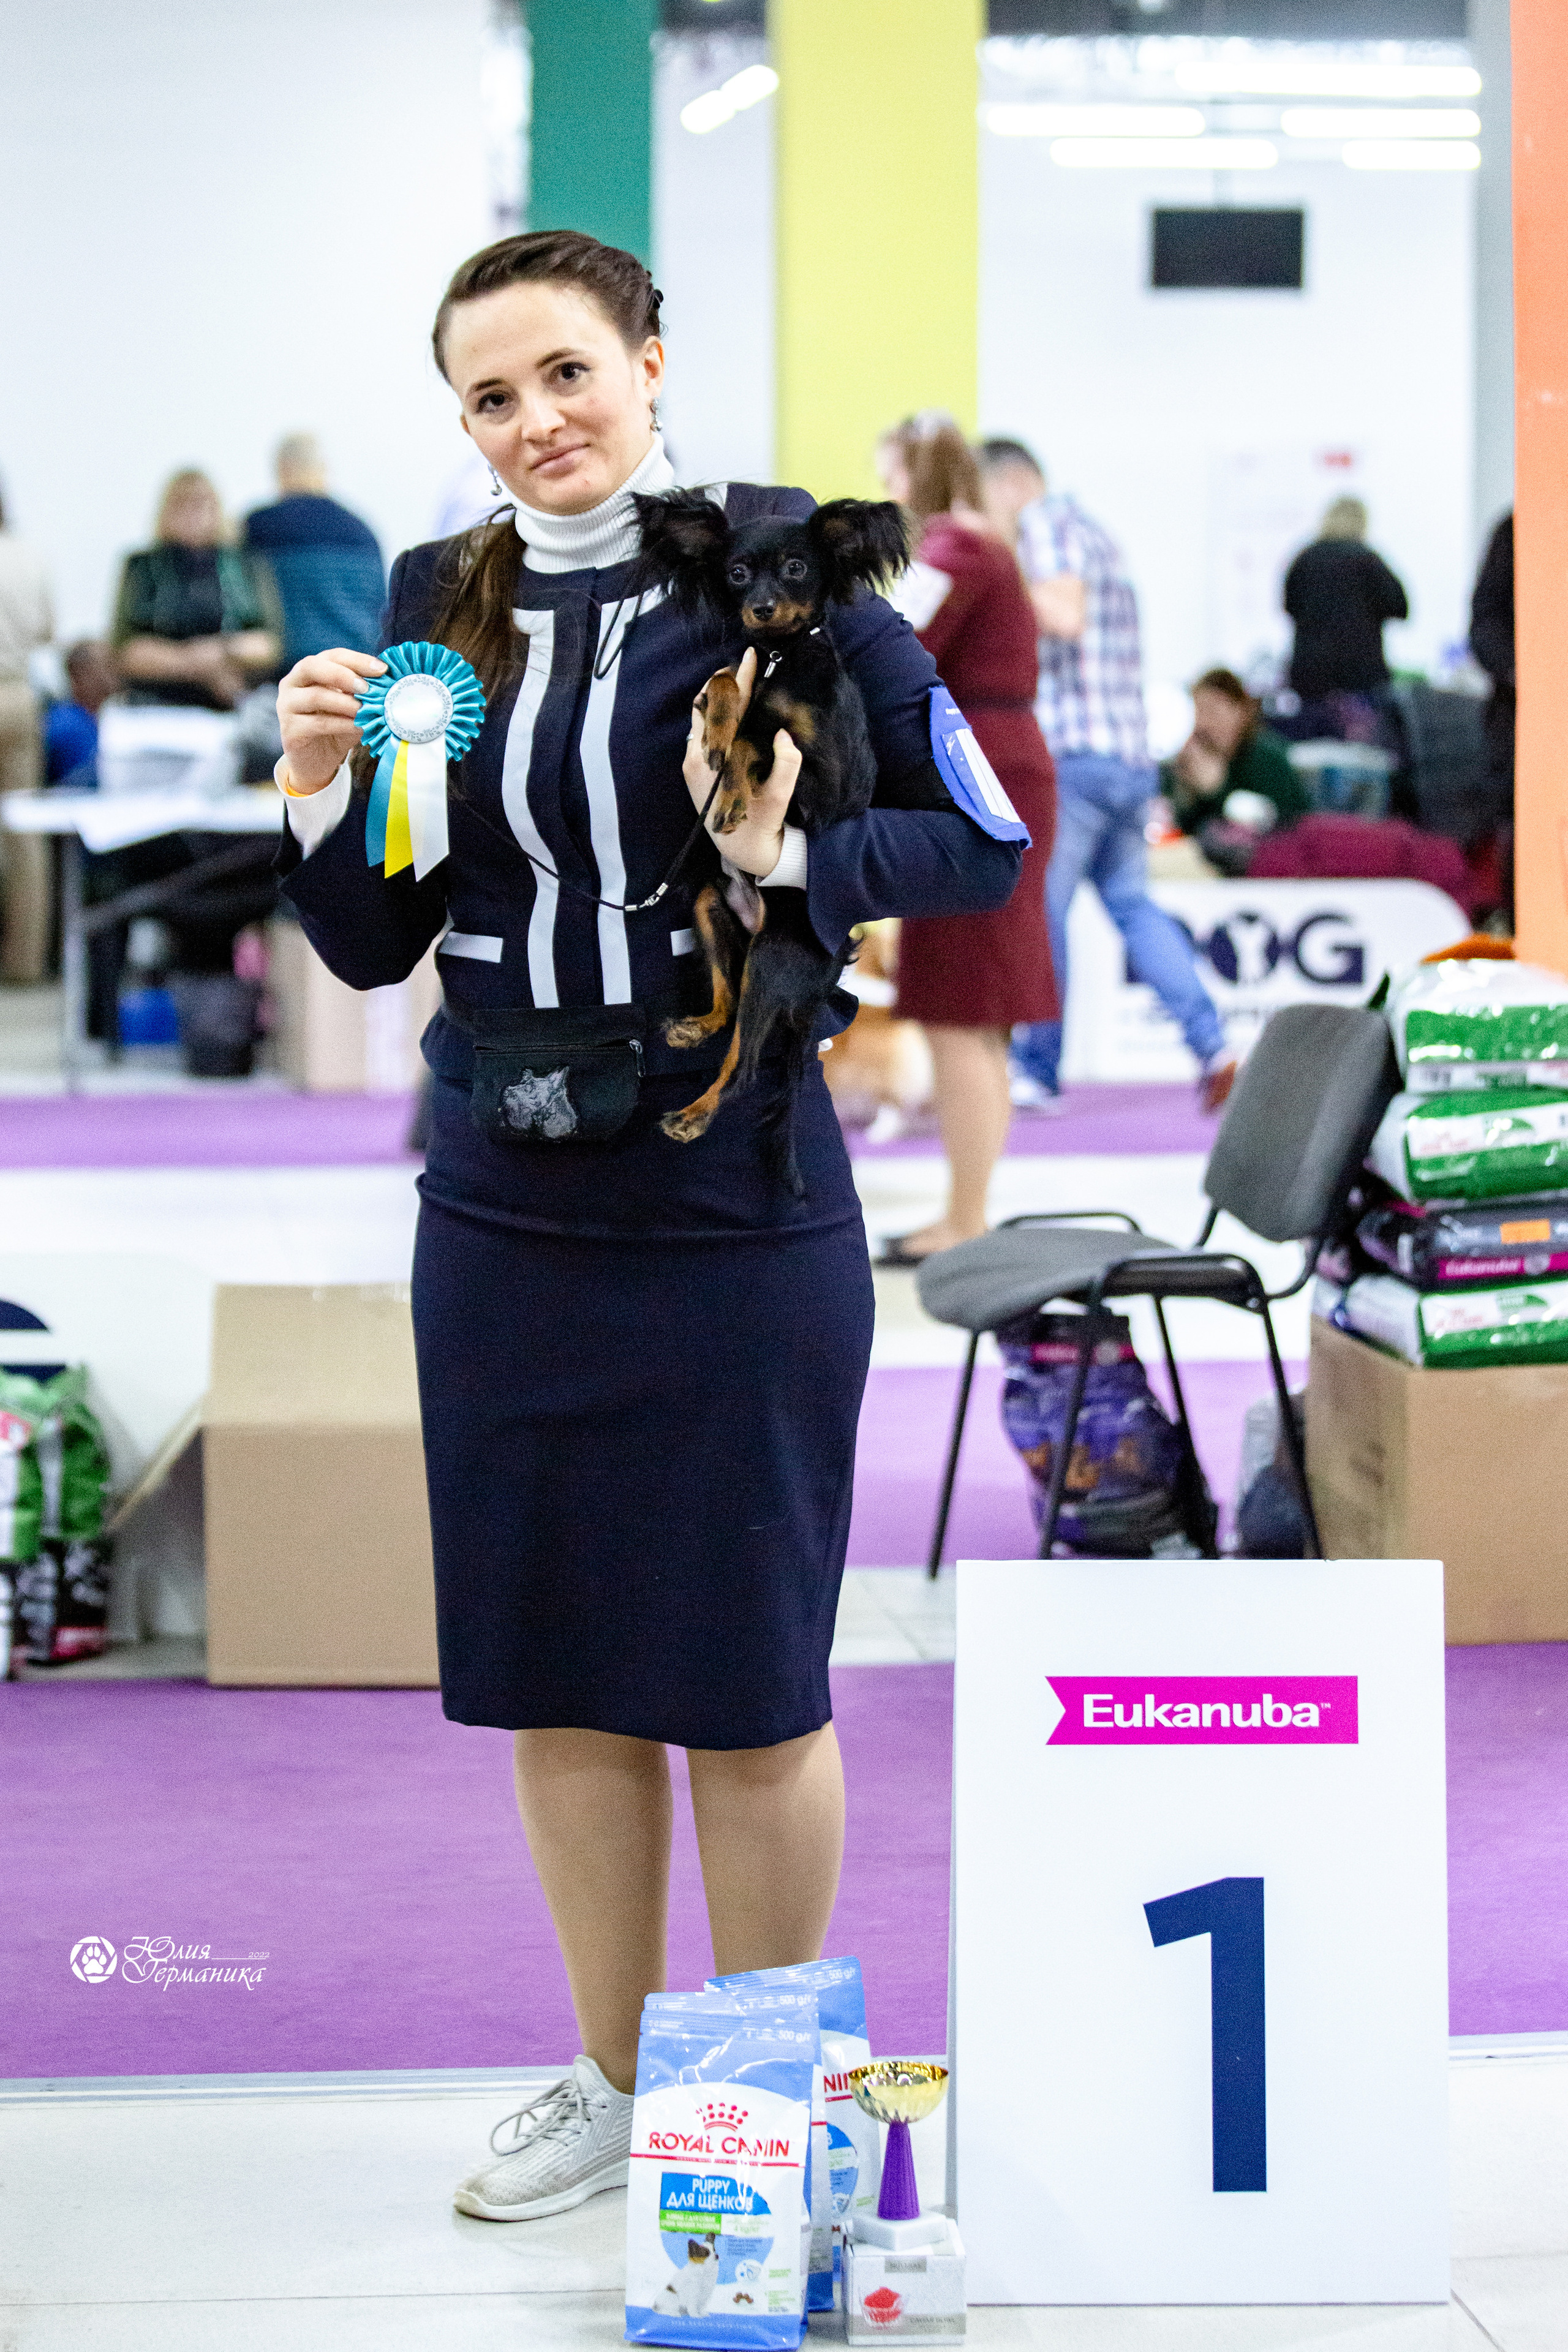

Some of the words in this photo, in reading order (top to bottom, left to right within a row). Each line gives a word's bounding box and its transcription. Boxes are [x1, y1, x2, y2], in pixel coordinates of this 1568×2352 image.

[1143, 1876, 1267, 2193] 1
[649, 2132, 714, 2154] ROYAL
[721, 2136, 790, 2157] CANIN
[692, 2177, 731, 2195] PUPPY
[666, 2191, 696, 2209] ДЛЯ
[698, 2193, 754, 2213] ЩЕНКОВ
